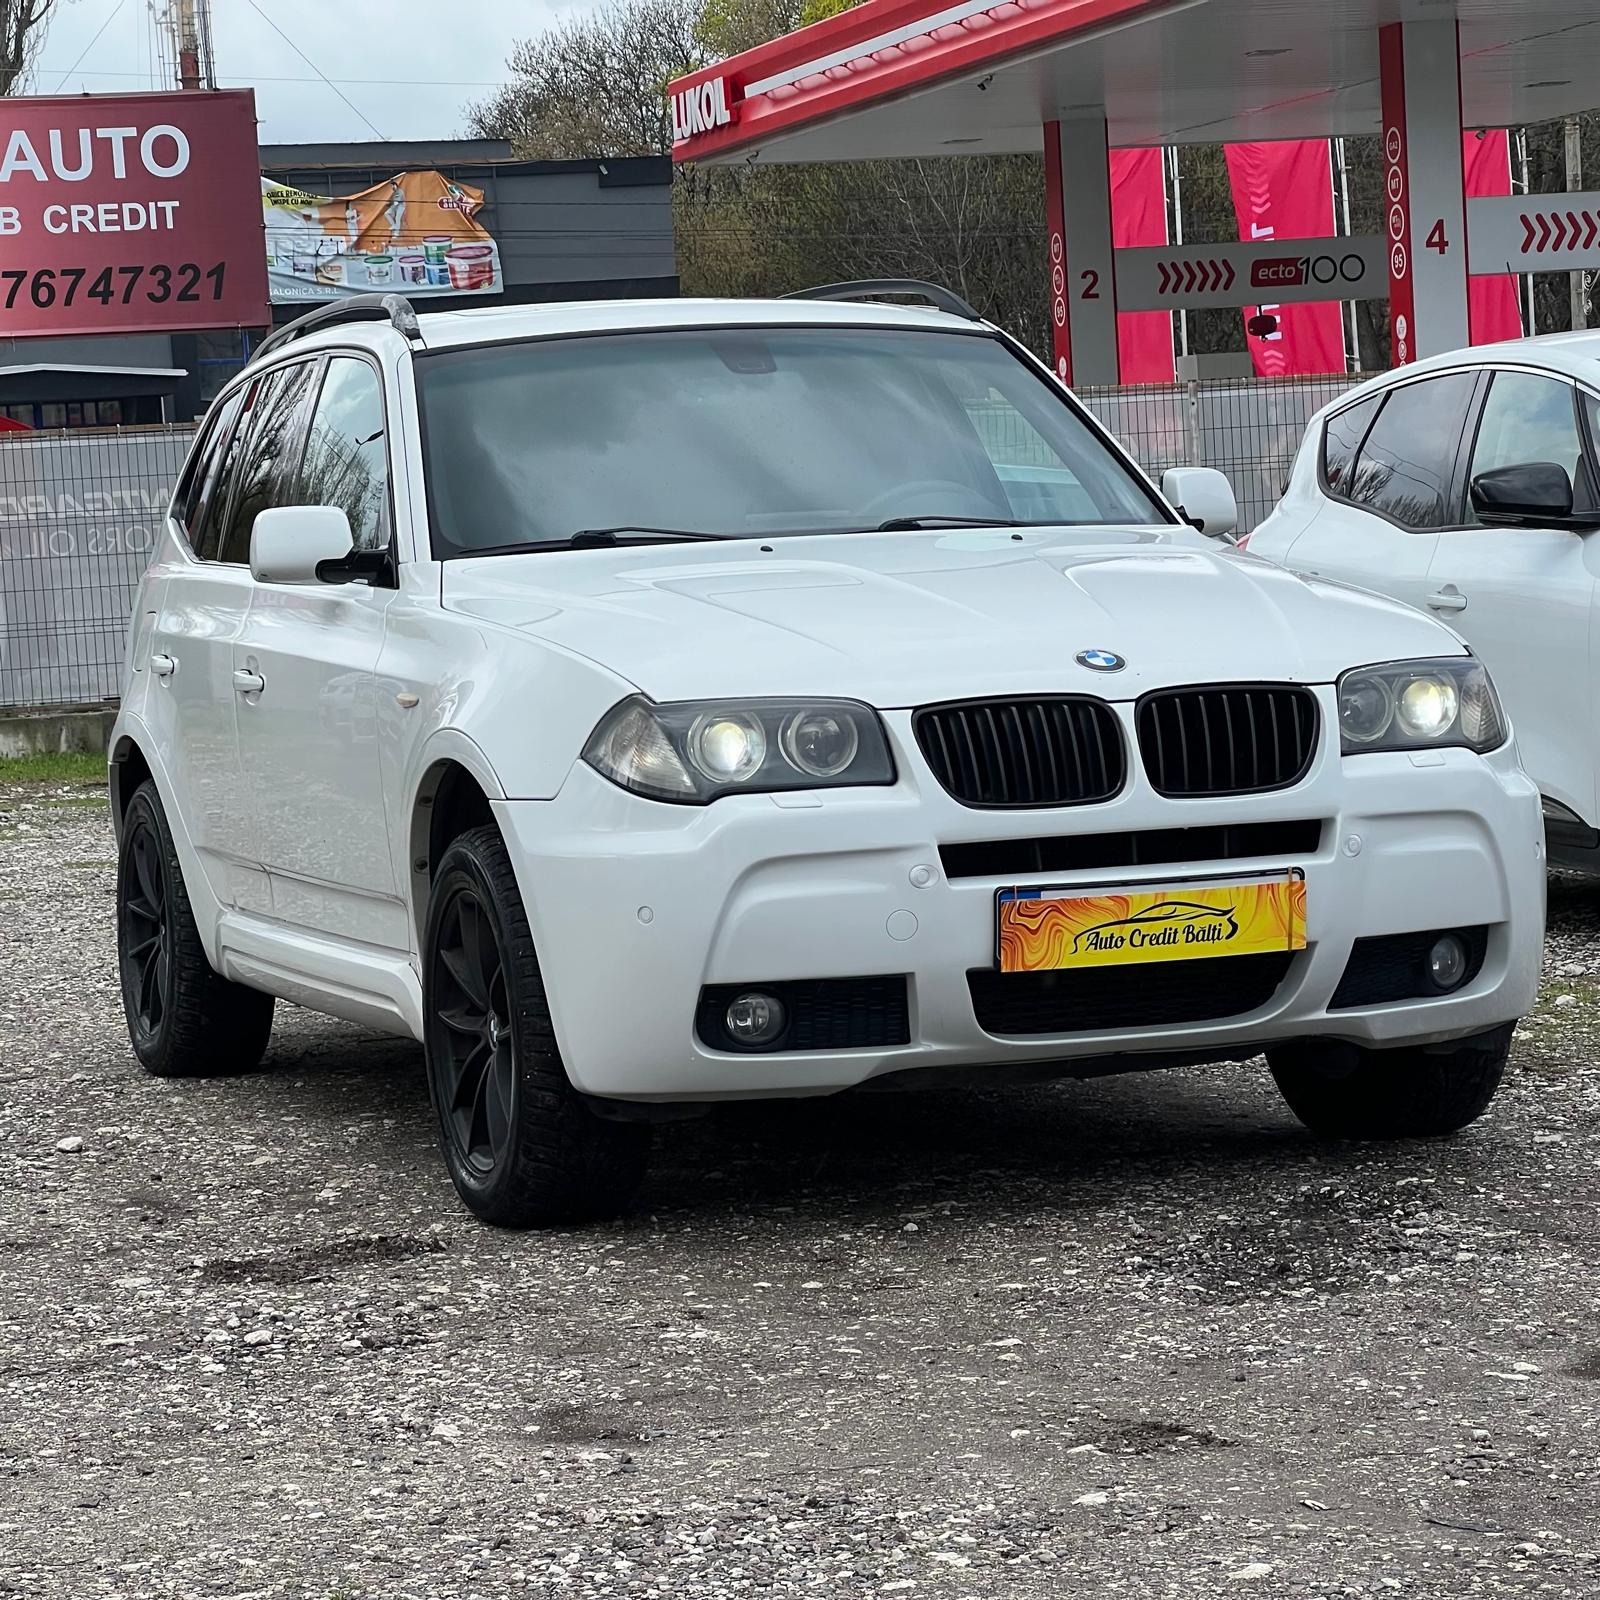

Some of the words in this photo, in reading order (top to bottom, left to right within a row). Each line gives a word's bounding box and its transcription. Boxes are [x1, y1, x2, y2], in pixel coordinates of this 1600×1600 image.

[671, 76, 730, 141] LUKOIL
[0, 124, 190, 183] AUTO
[43, 201, 180, 235] CREDIT
[1425, 218, 1449, 255] 4
[1394, 252, 1403, 268] 95
[1, 261, 226, 309] 76747321
[1080, 269, 1100, 300] 2
[1056, 305, 1063, 318] 95
[1086, 931, 1126, 952] Auto
[1129, 927, 1179, 948] Credit
